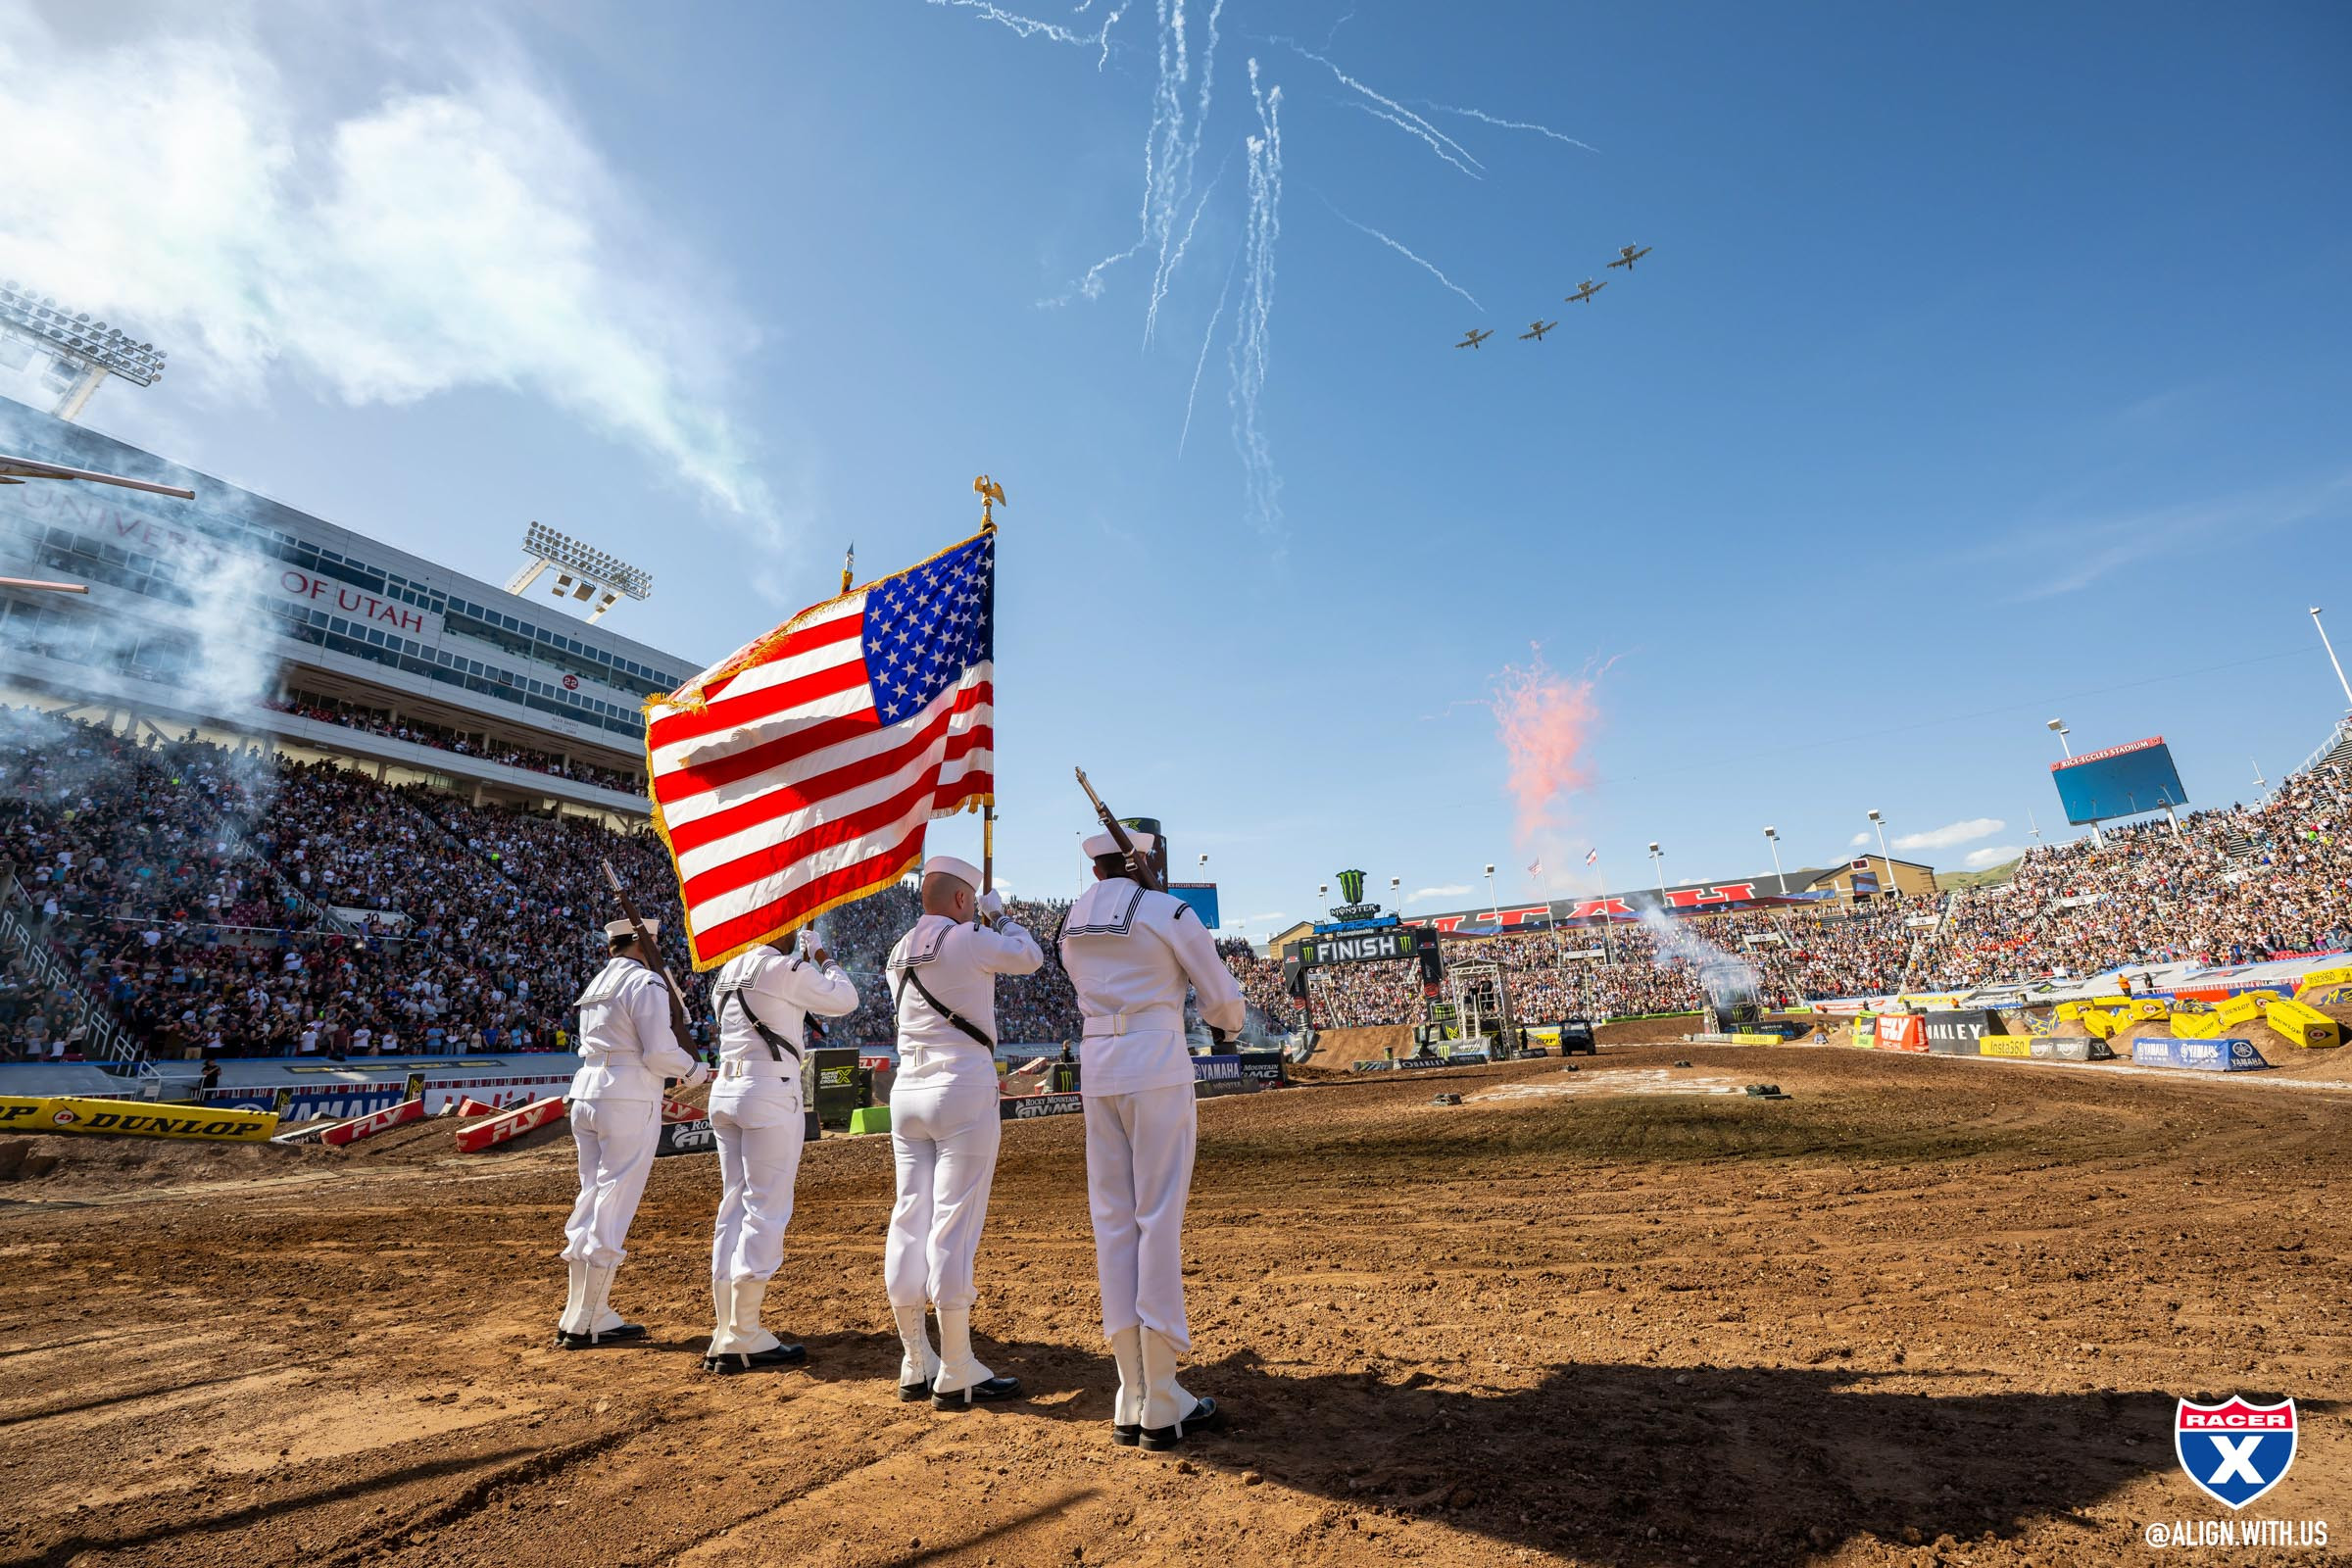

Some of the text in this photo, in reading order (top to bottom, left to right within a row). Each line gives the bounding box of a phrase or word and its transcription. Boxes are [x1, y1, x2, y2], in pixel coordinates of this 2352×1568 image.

[281, 571, 328, 599] OF
[338, 589, 422, 633] UTAH
[564, 677, 577, 687] 22
[2062, 741, 2149, 767] RICE-ECCLES STADIUM
[365, 913, 380, 923] 10
[1337, 928, 1374, 937] Championship
[1317, 936, 1396, 962] FINISH
[2225, 1003, 2250, 1015] DUNLOP
[1927, 1024, 1983, 1040] OAKLEY
[2273, 1015, 2301, 1035] DUNLOP
[1990, 1041, 2024, 1054] Insta360
[2144, 1043, 2169, 1056] YAMAHA
[1201, 1062, 1240, 1079] YAMAHA
[1025, 1098, 1046, 1106] ROCKY
[82, 1112, 264, 1137] DUNLOP
[352, 1107, 405, 1139] FLY
[492, 1107, 546, 1144] FLY
